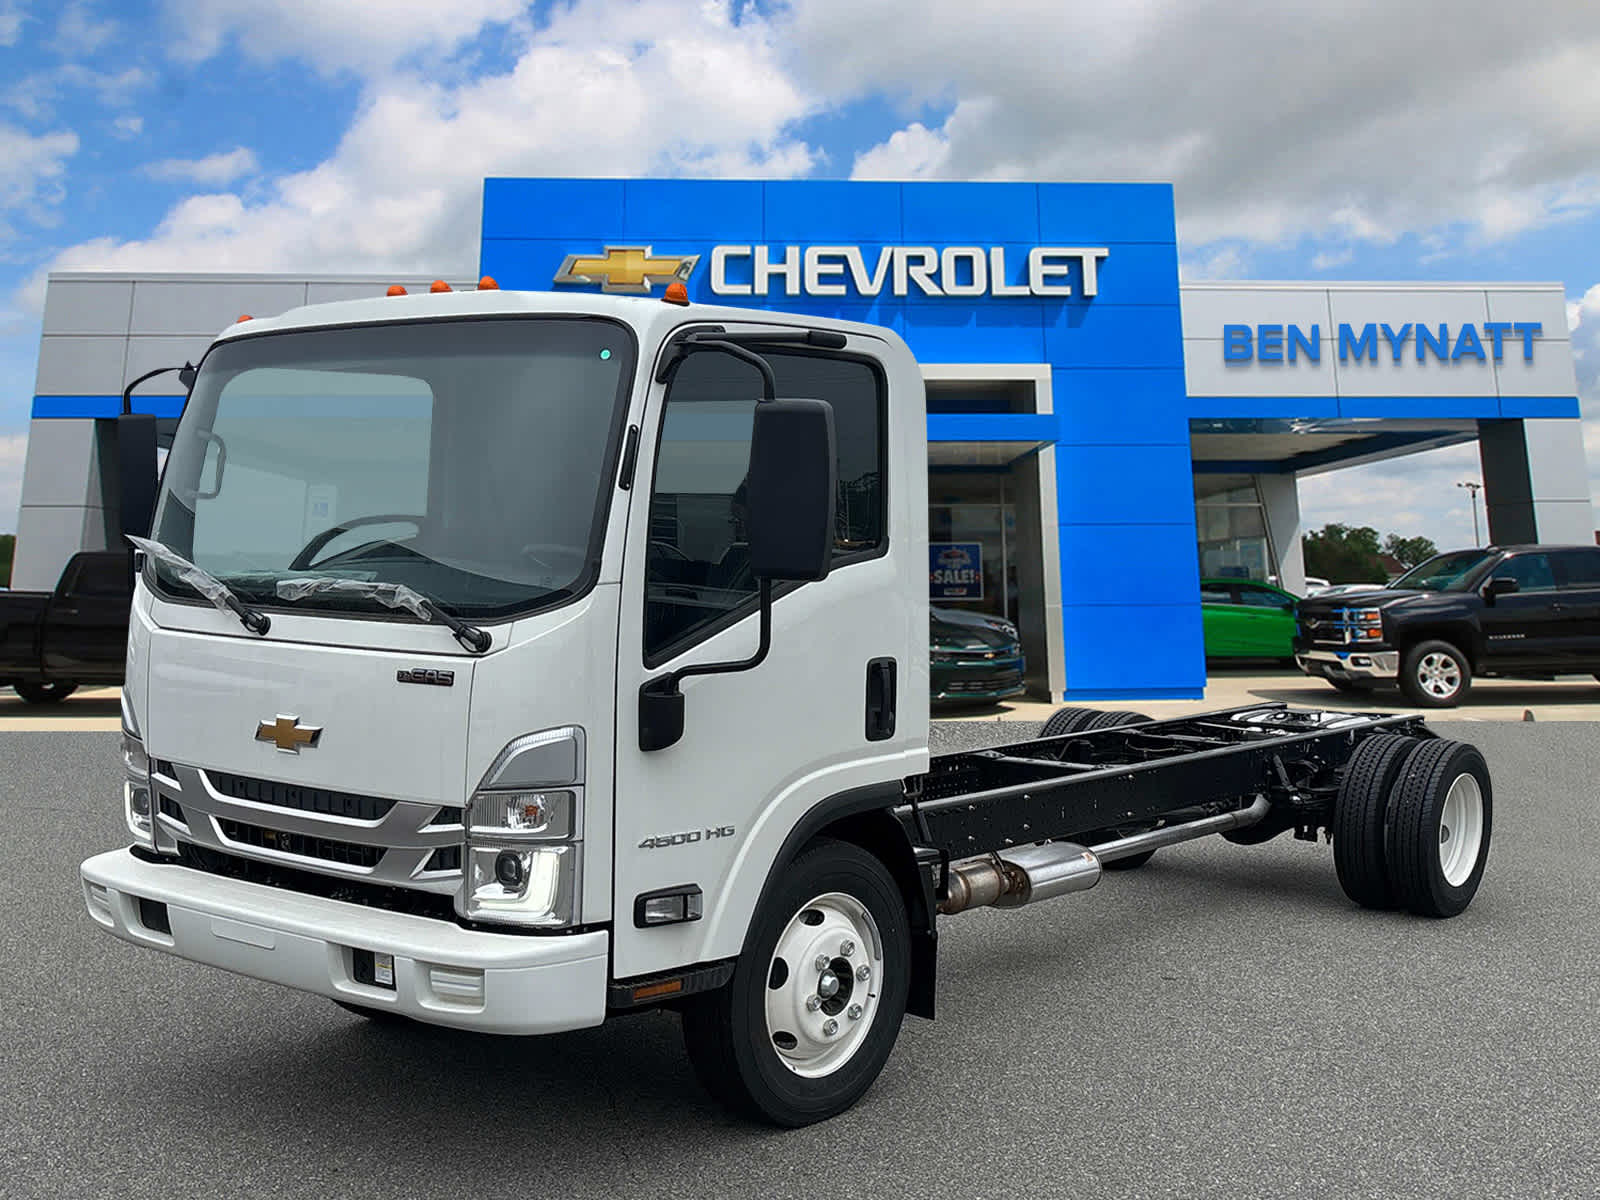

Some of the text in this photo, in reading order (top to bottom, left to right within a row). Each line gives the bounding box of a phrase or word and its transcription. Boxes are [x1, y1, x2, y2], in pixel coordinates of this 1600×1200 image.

[710, 245, 1110, 296] CHEVROLET
[1223, 322, 1543, 363] BEN MYNATT
[934, 569, 975, 584] SALE!
[638, 825, 735, 849] 4500 HG
